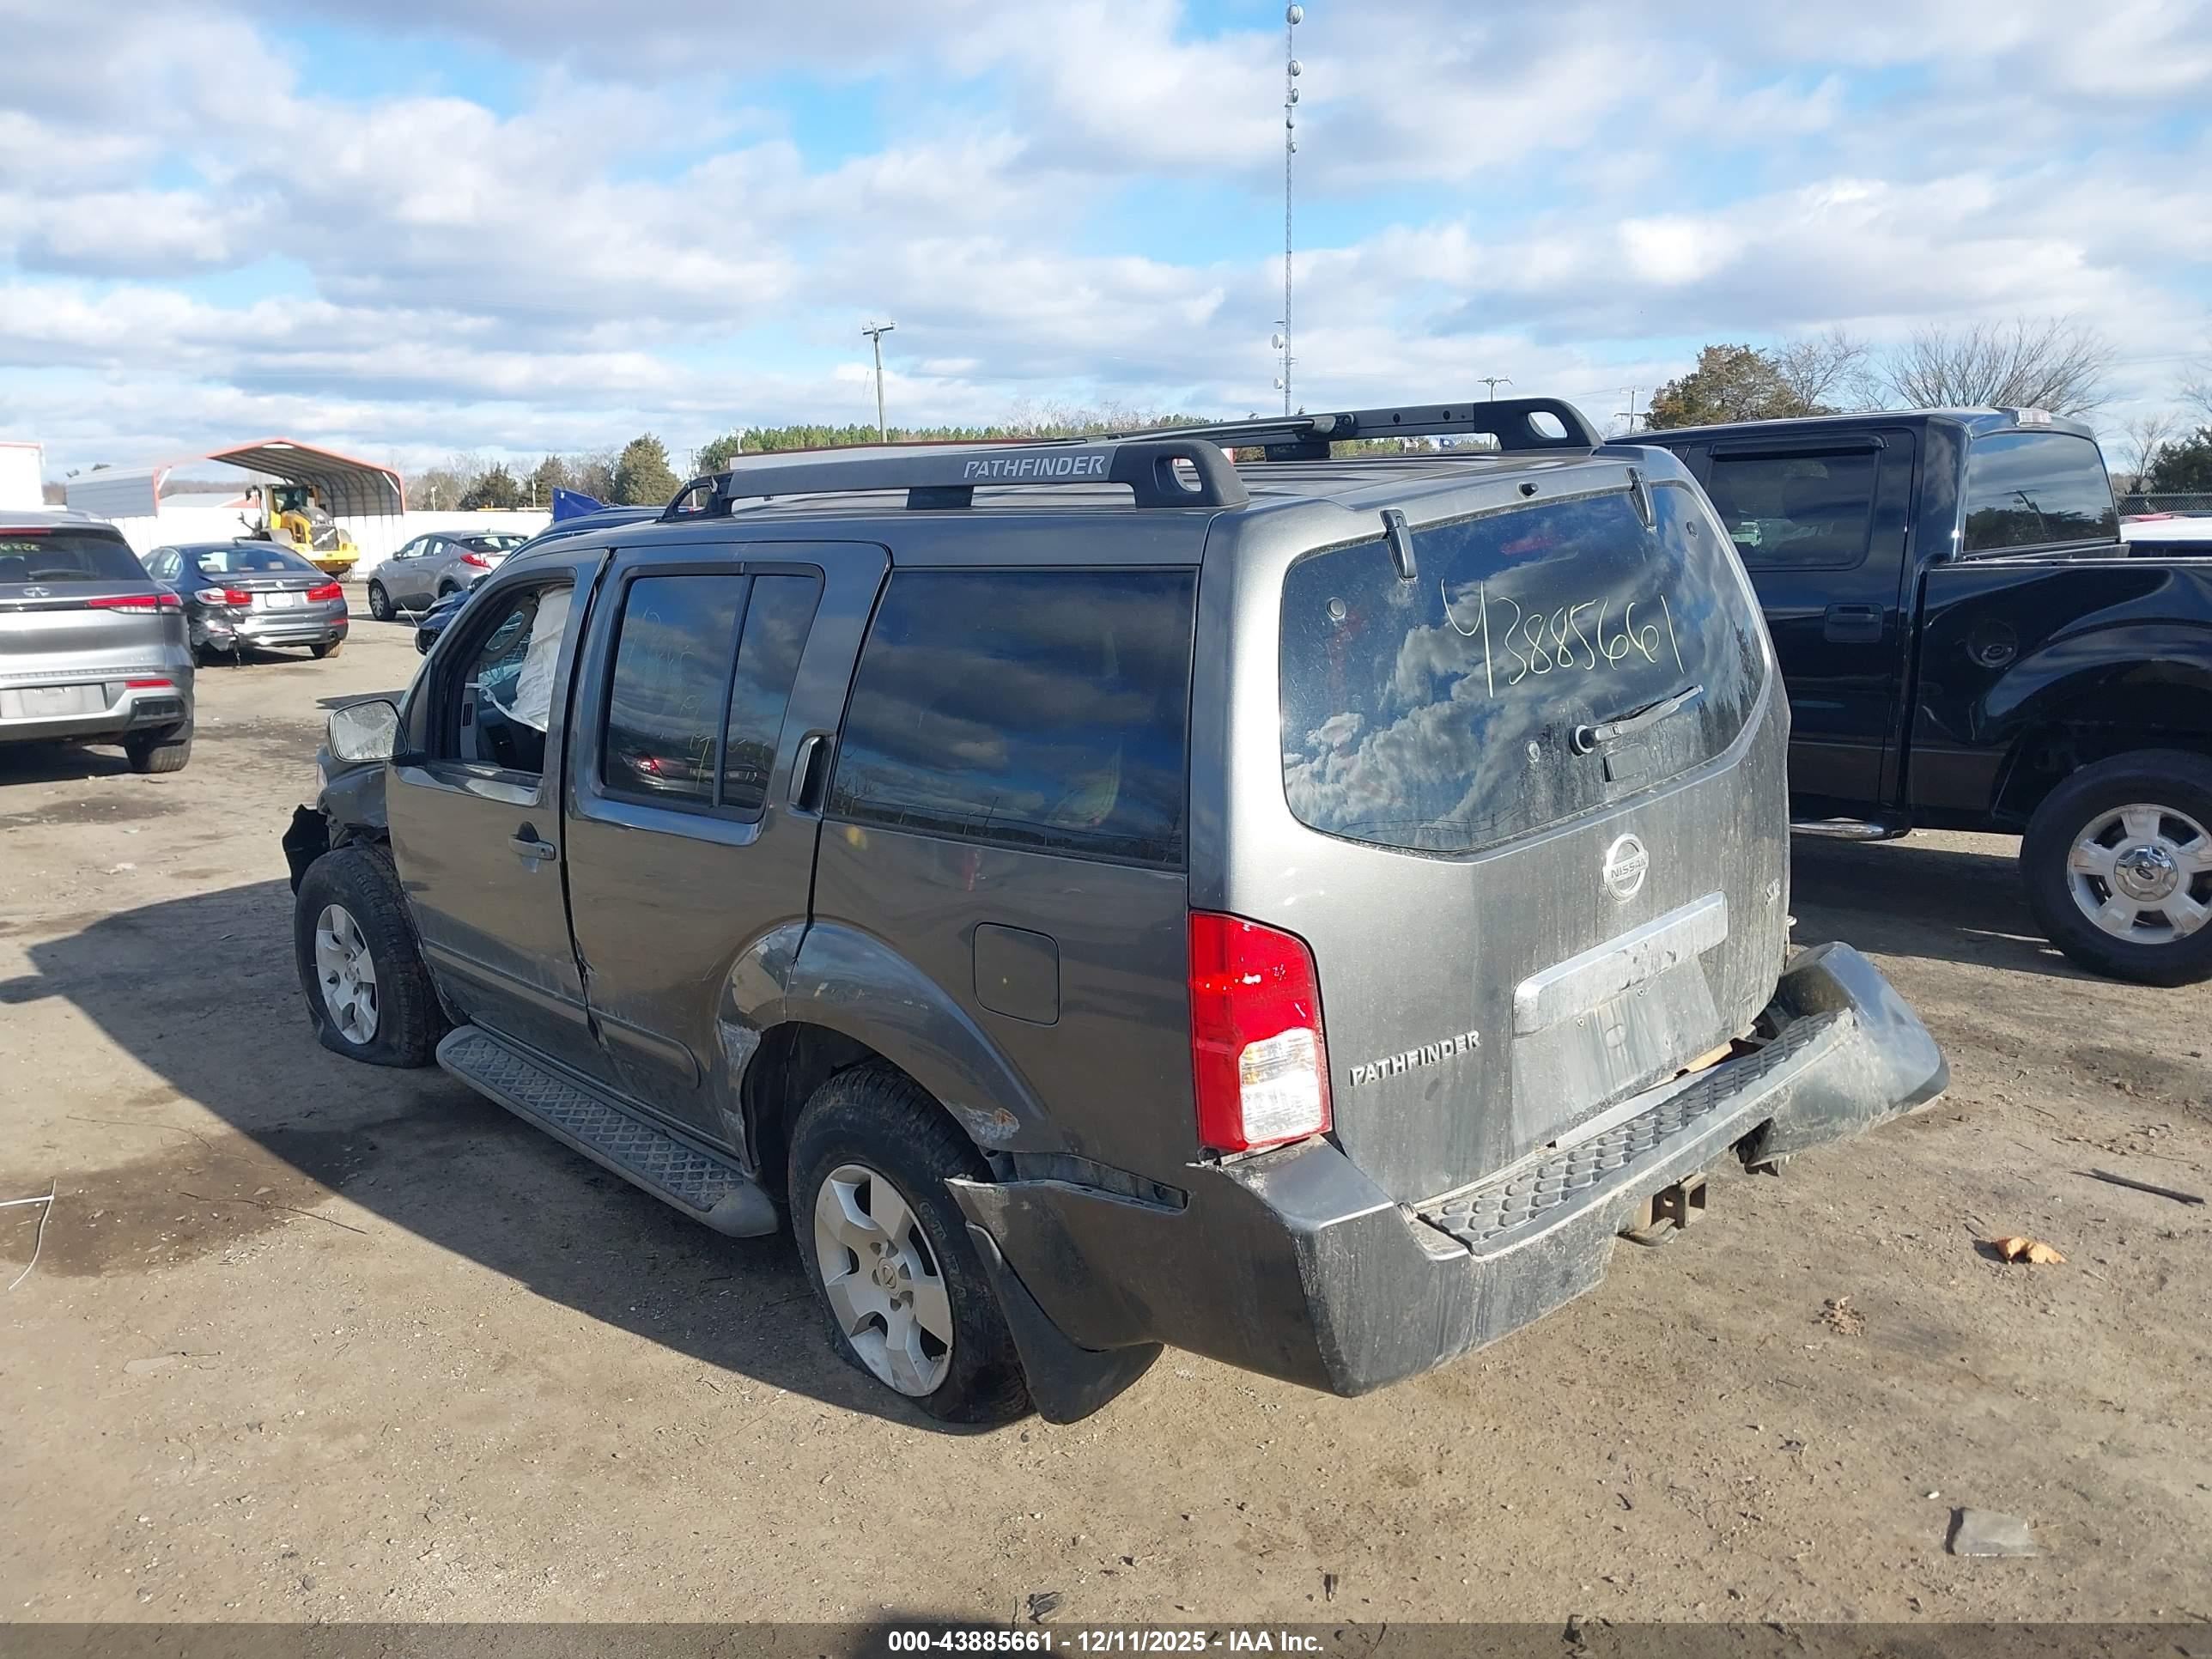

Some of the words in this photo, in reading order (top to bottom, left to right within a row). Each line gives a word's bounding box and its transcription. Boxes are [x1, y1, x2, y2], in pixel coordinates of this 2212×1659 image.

[963, 455, 1106, 479] PATHFINDER
[1441, 578, 1685, 698] 43885661
[1610, 857, 1648, 879] NISSAN
[1348, 1030, 1483, 1087] PATHFINDER
